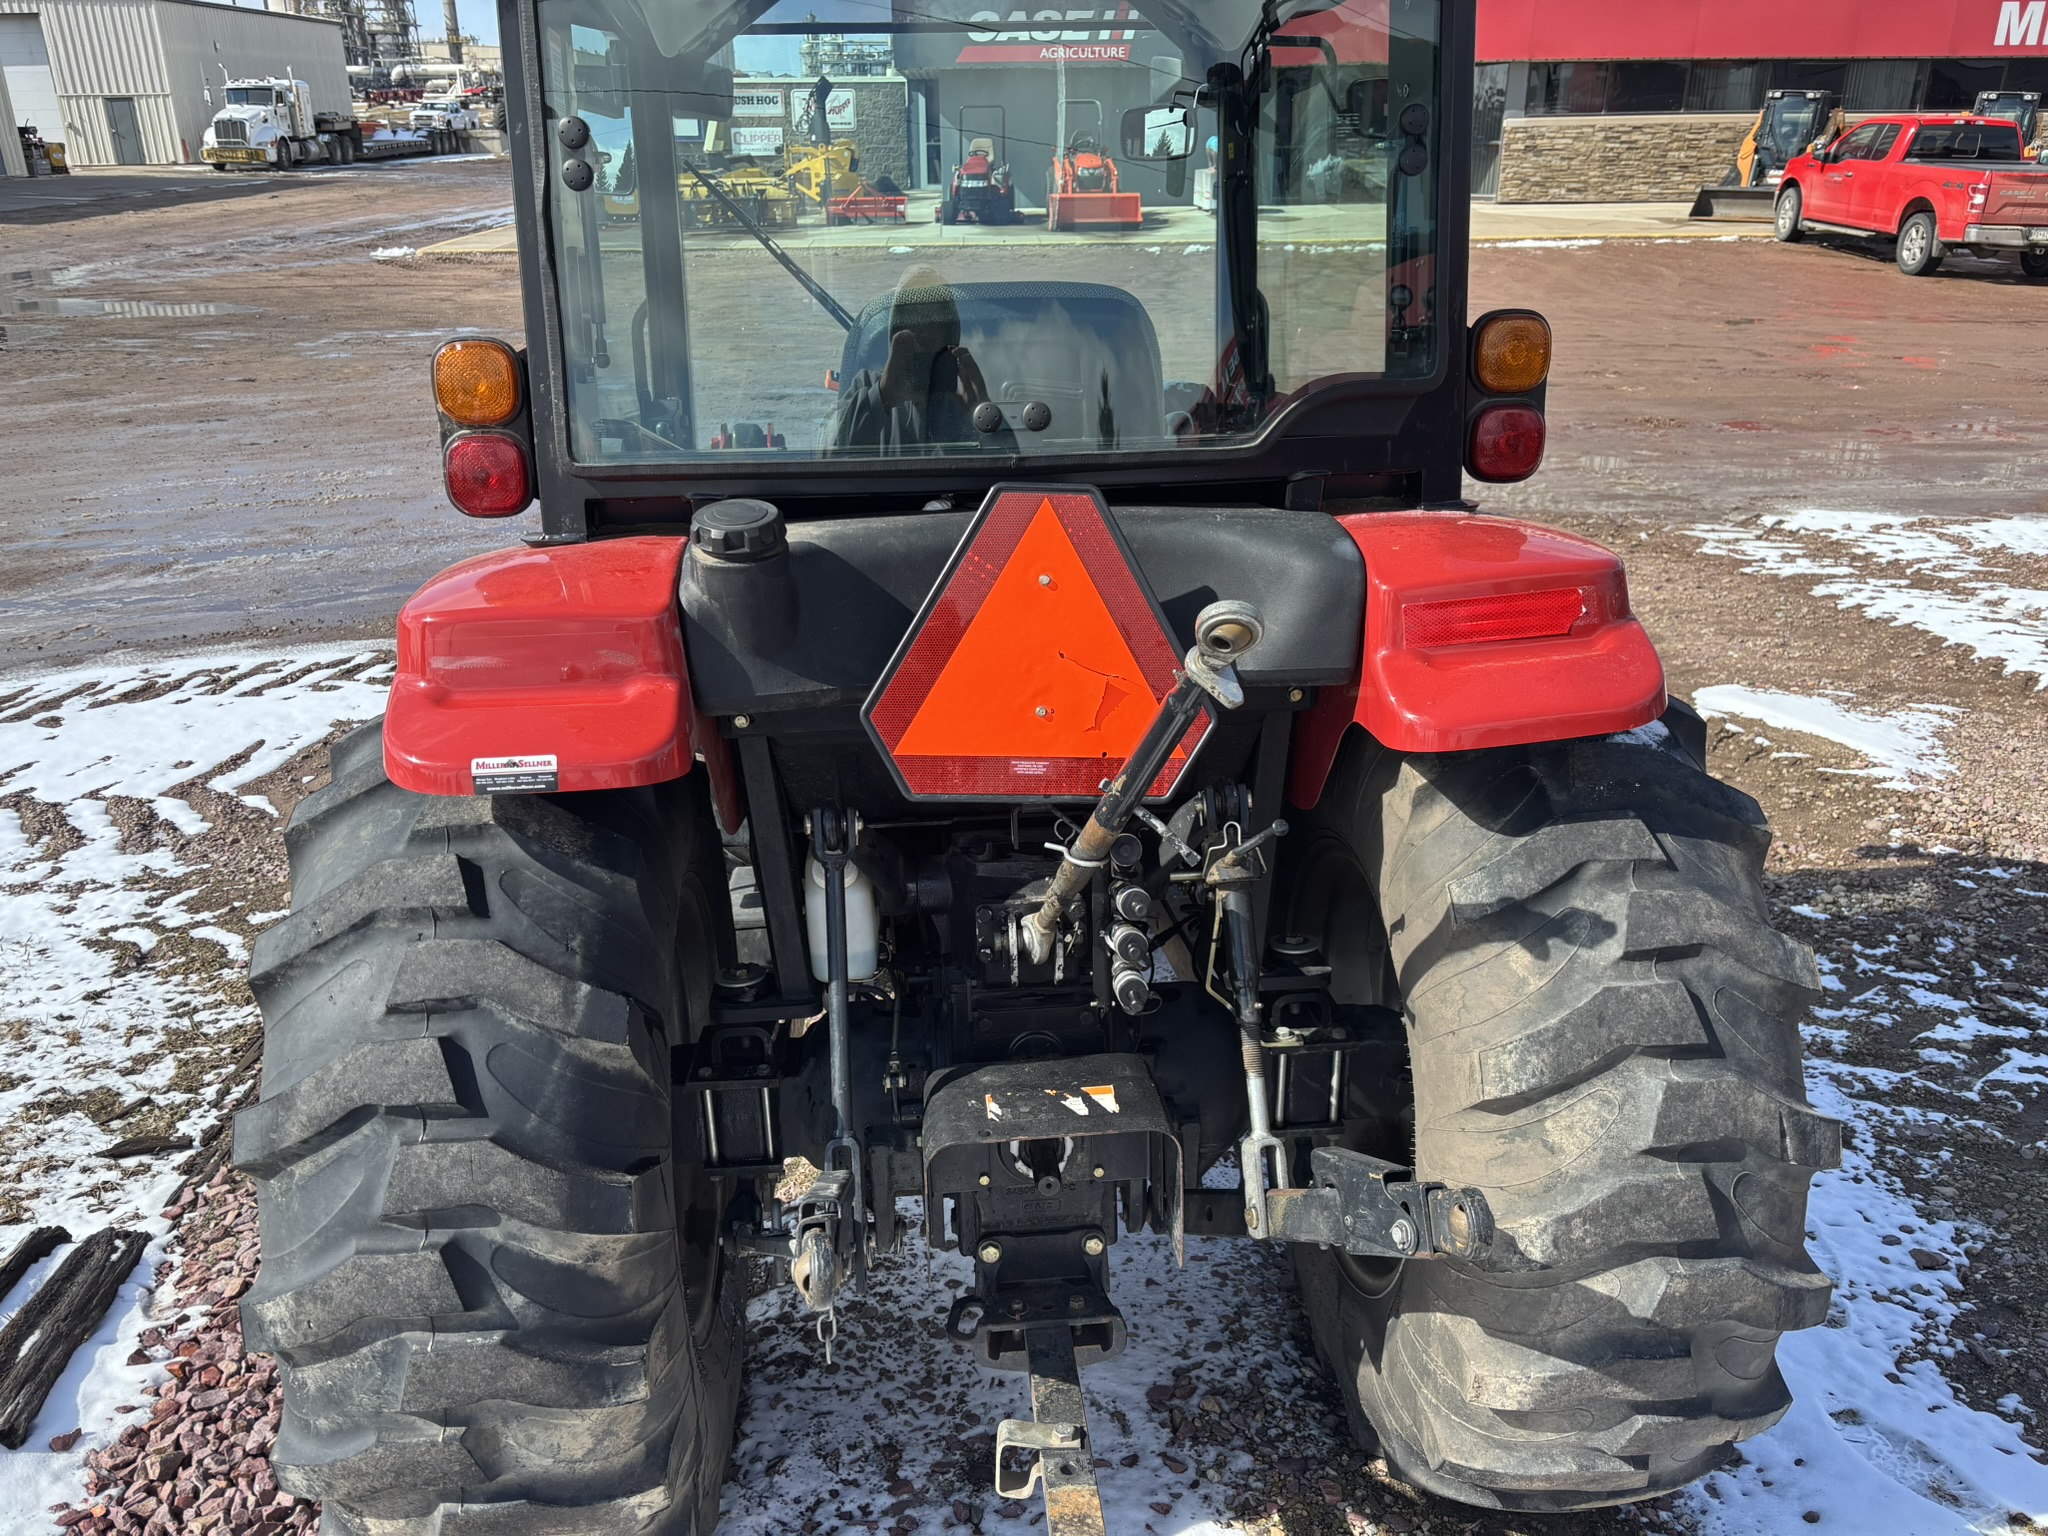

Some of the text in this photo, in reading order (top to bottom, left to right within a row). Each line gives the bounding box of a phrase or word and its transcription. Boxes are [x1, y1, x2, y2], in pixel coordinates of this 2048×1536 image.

[967, 10, 1095, 42] CASE
[1039, 46, 1126, 59] AGRICULTURE
[734, 95, 780, 106] USH HOG
[733, 131, 781, 145] CLIPPER
[476, 760, 553, 770] MILLER SELLNER
